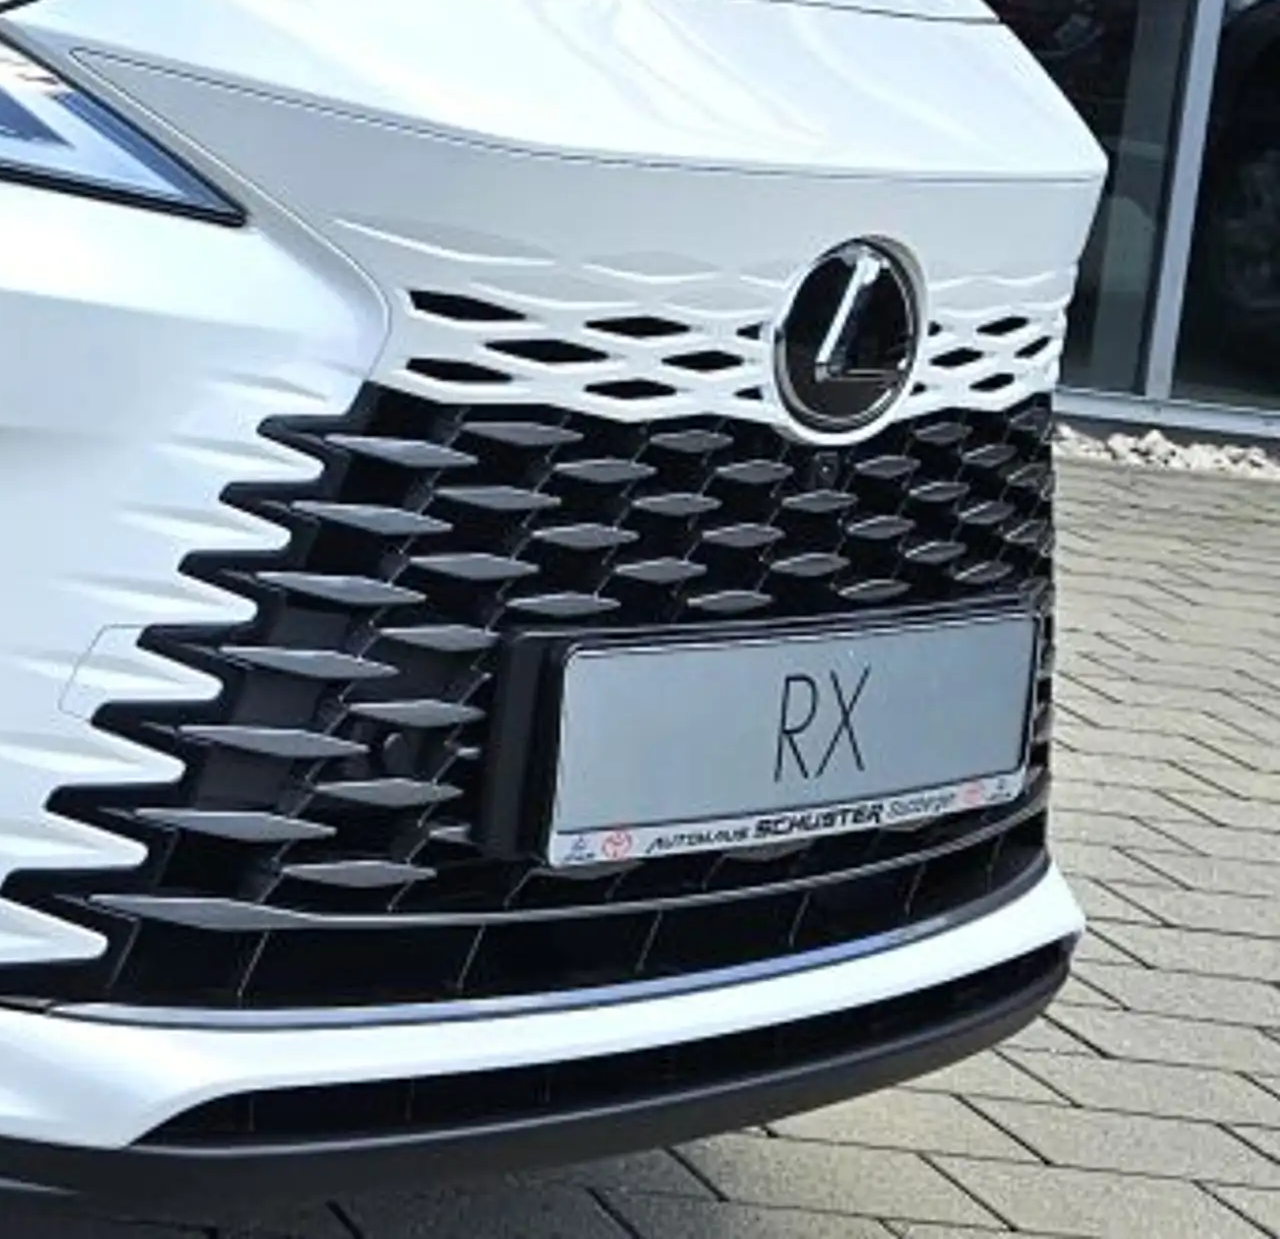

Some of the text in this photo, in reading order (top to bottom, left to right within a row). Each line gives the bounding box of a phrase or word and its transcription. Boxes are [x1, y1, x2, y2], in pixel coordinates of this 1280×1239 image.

[774, 665, 871, 781] RX
[647, 828, 749, 853] AUTOHAUS
[755, 805, 884, 838] SCHUSTER
